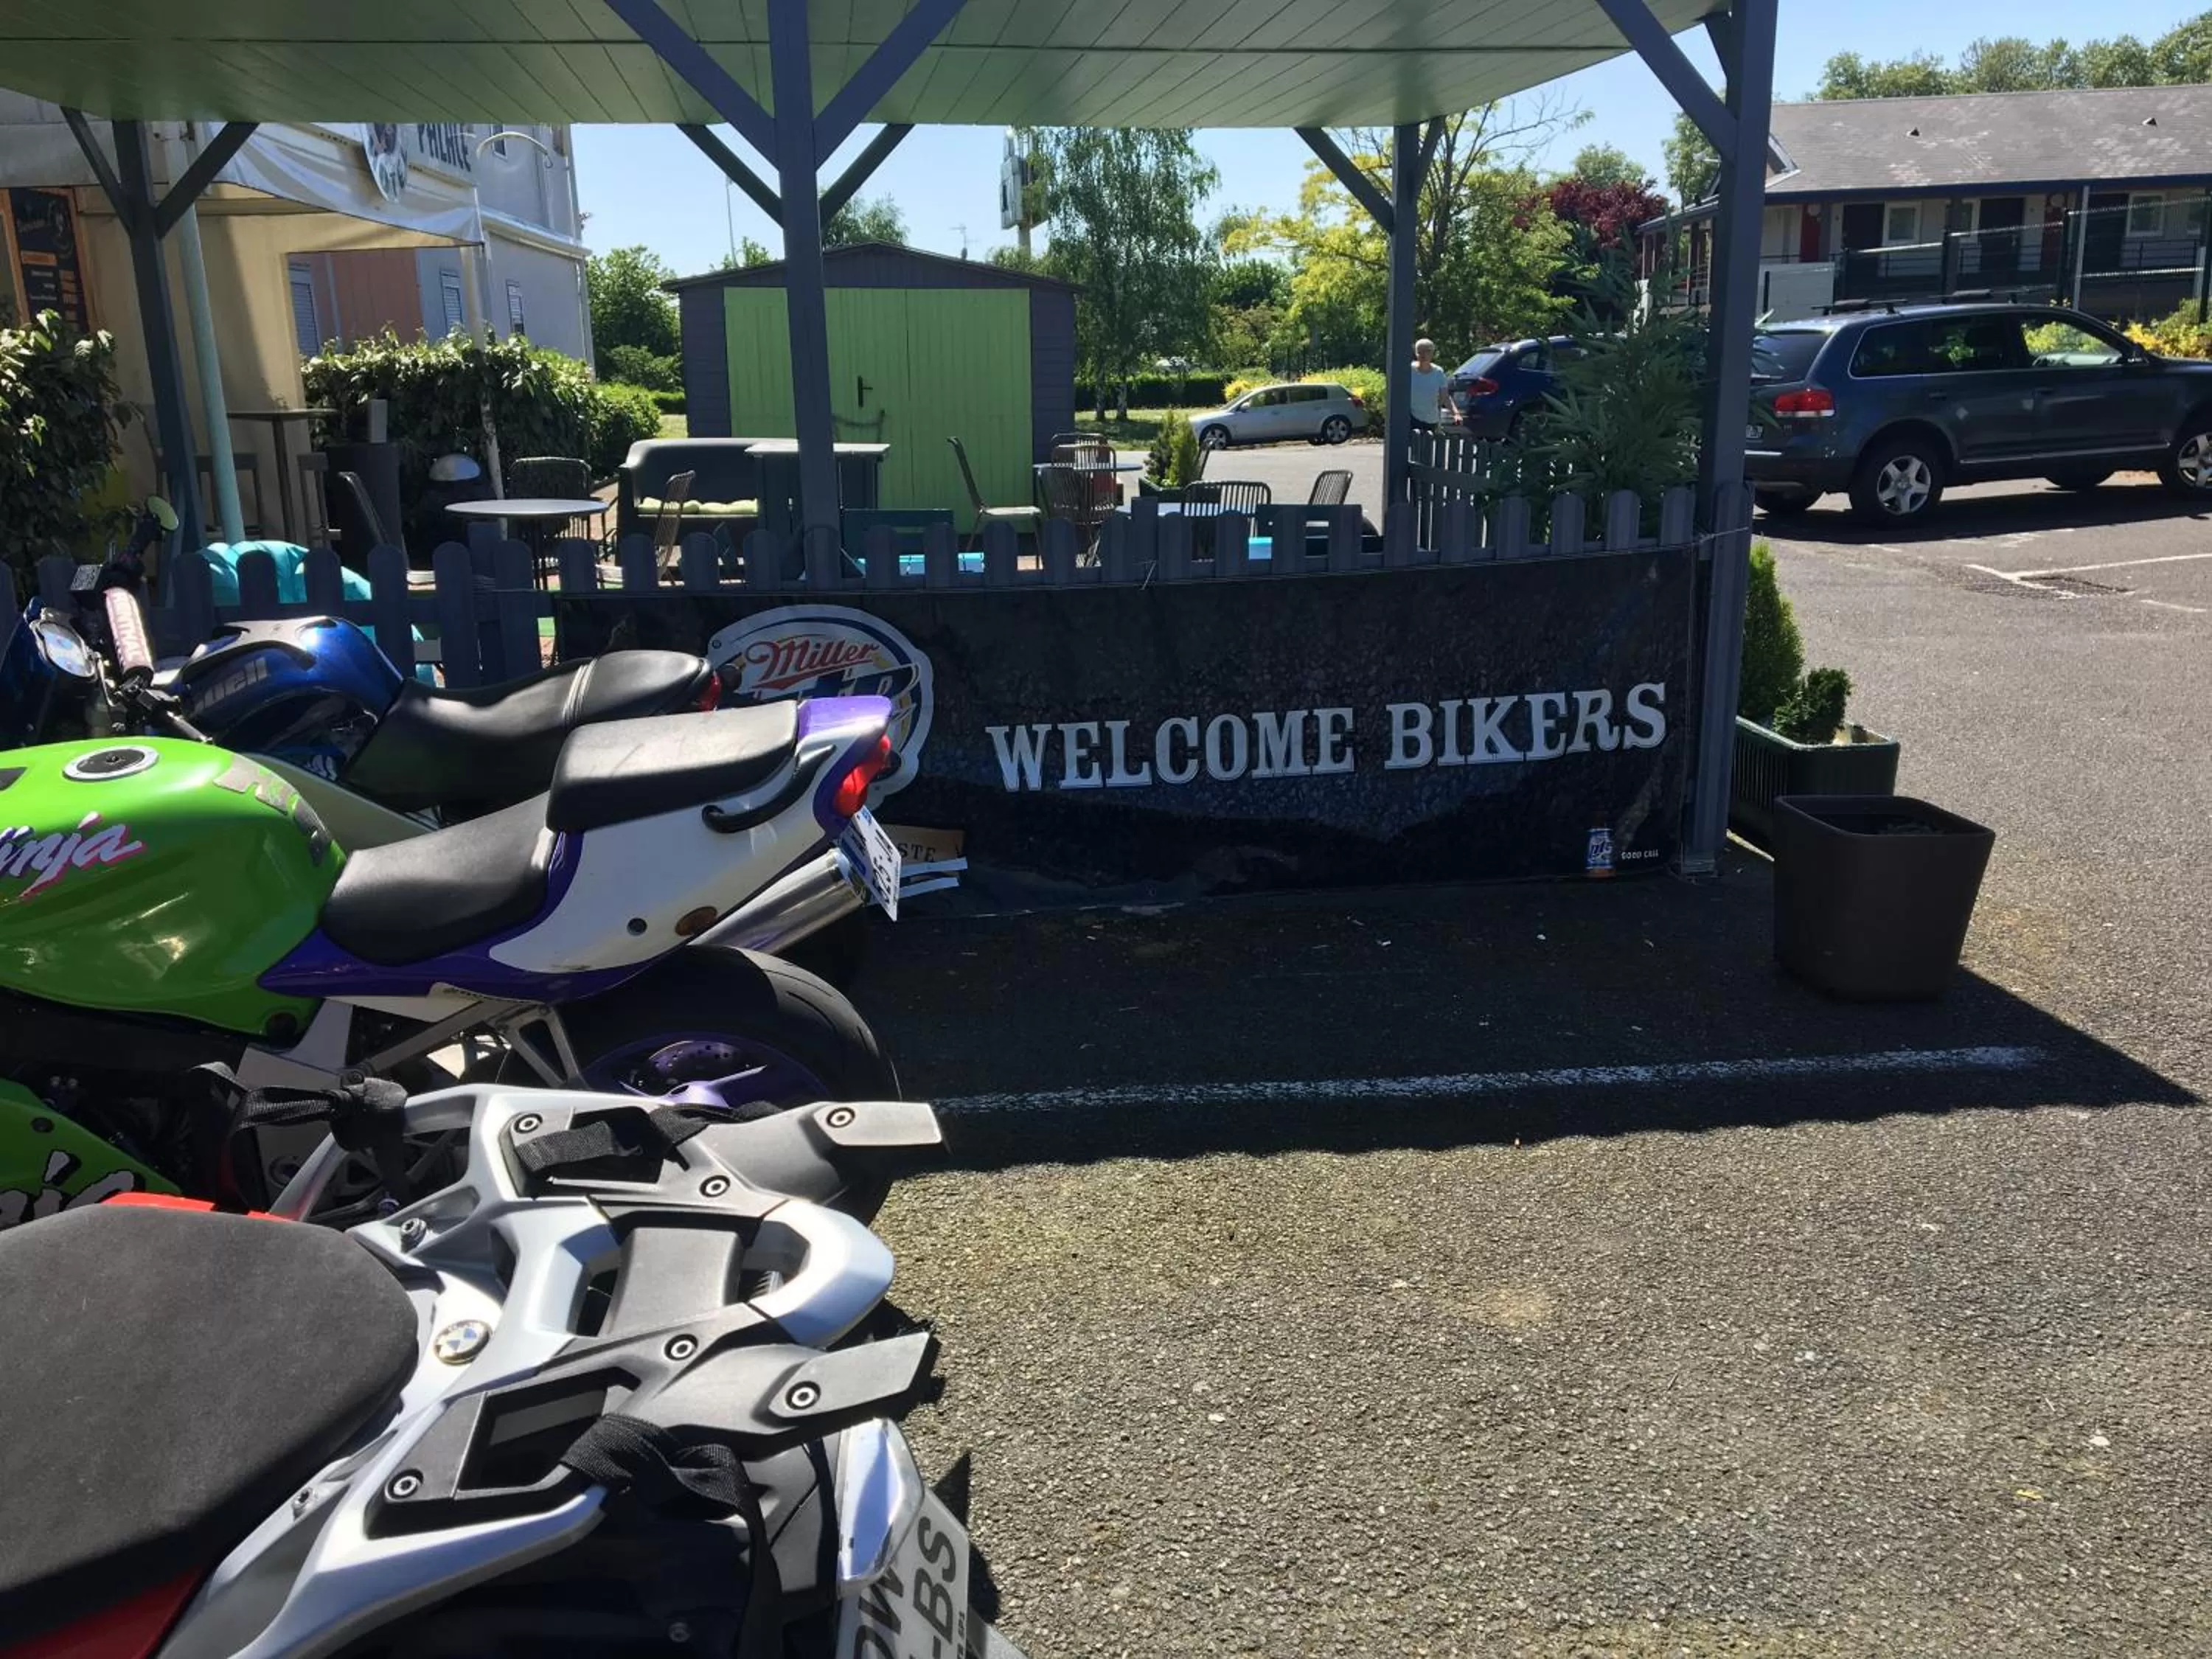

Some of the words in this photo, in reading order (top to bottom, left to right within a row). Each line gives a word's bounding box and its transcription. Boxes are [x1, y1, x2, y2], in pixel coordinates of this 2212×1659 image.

[745, 637, 880, 682] Miller
[985, 706, 1355, 792] WELCOME
[1384, 682, 1667, 770] BIKERS
[0, 810, 146, 900] inja
